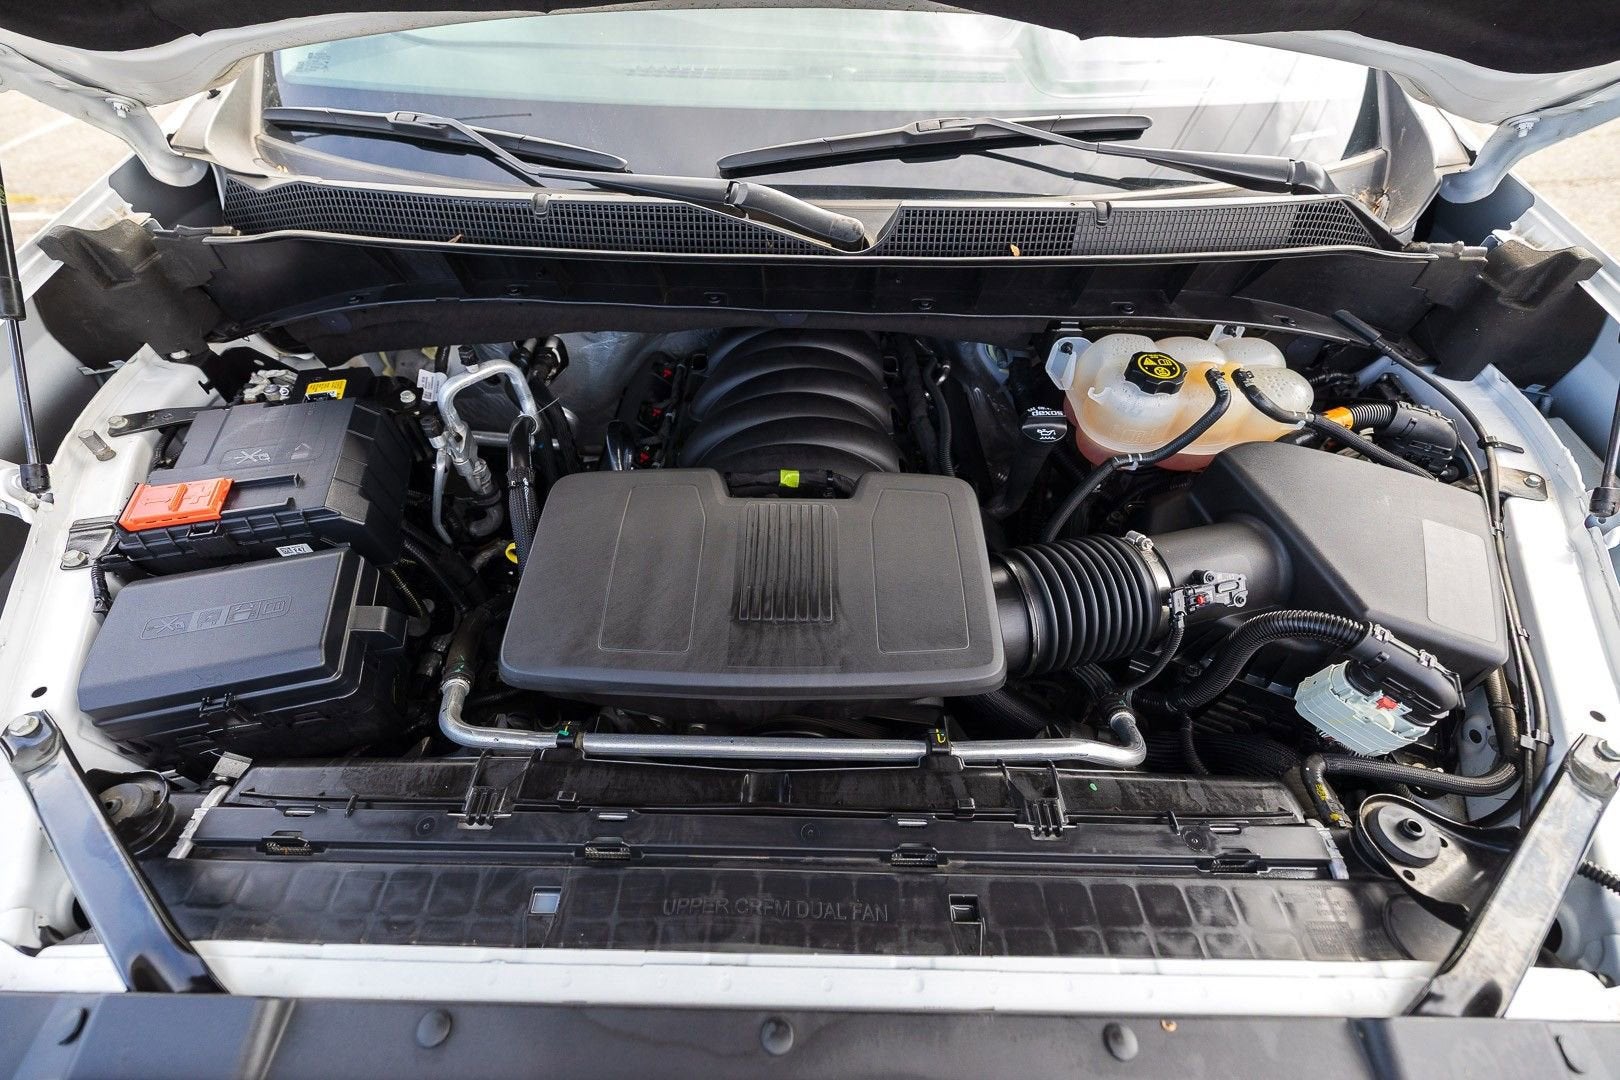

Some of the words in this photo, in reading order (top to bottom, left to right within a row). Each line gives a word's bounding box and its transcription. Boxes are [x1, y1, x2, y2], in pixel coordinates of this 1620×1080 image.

[662, 897, 728, 915] UPPER
[796, 900, 847, 920] DUAL
[852, 902, 888, 921] FAN
